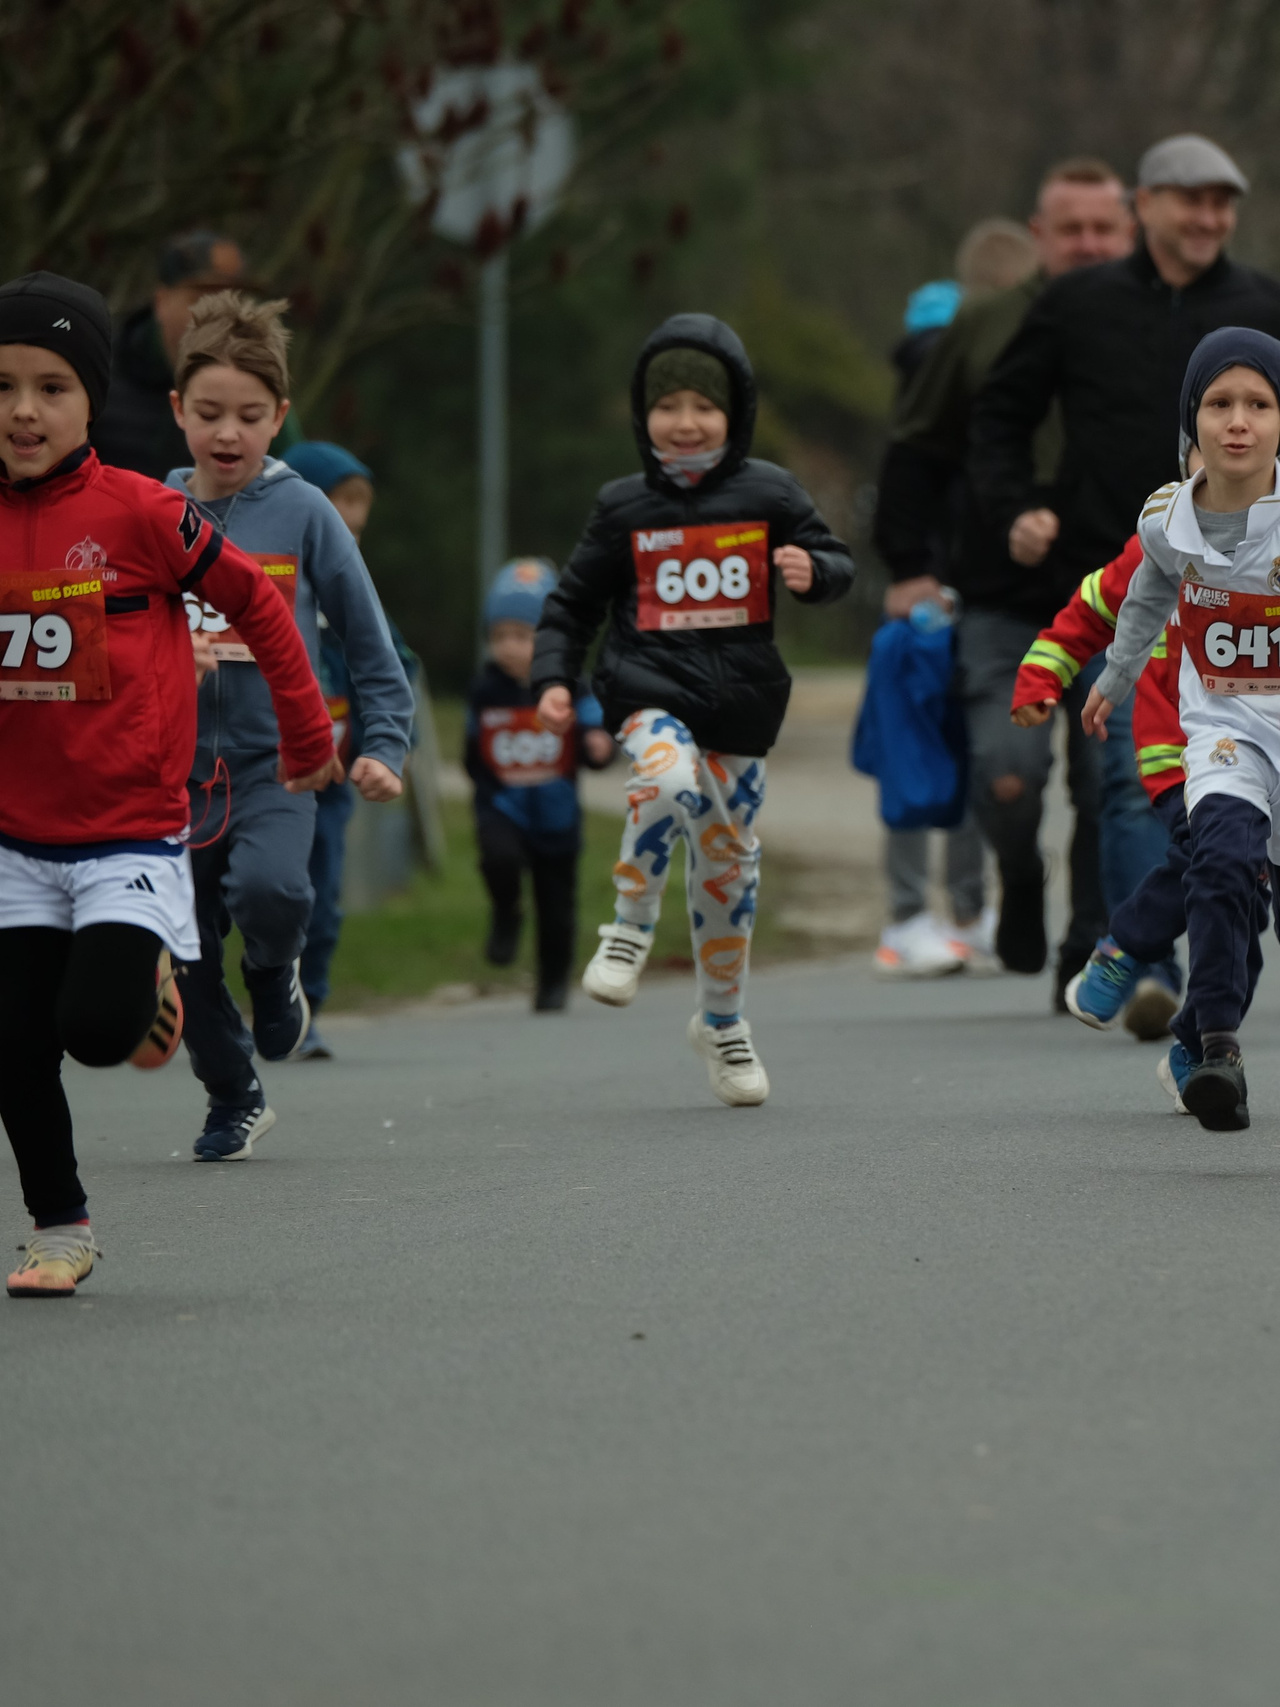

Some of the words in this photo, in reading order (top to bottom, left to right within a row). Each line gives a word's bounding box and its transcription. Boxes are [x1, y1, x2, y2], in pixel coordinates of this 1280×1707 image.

[32, 587, 61, 602] BIEG
[62, 580, 101, 598] DZIECI
[656, 555, 750, 604] 608
[1202, 588, 1230, 602] BIEG
[0, 613, 72, 669] 79
